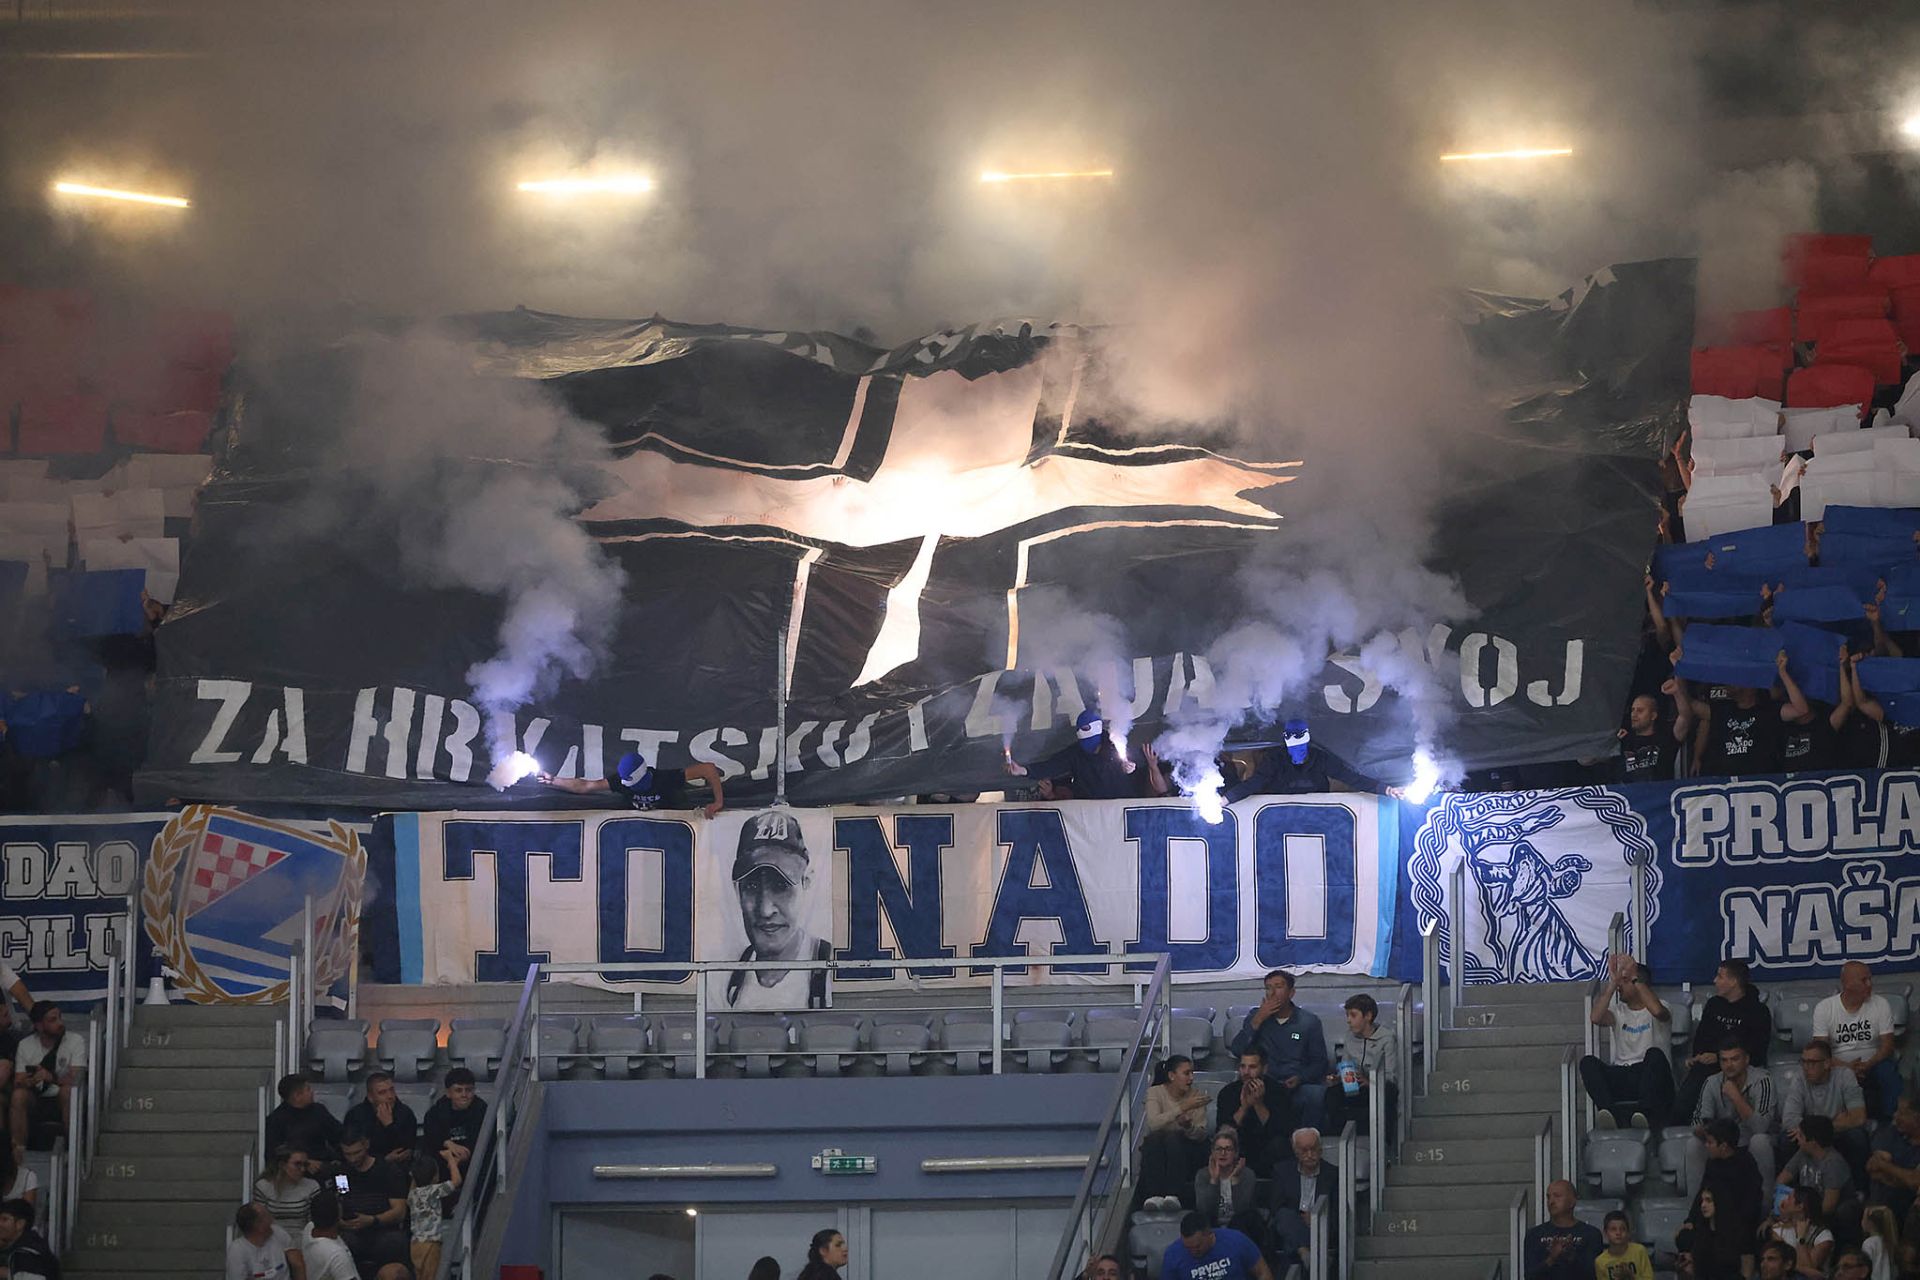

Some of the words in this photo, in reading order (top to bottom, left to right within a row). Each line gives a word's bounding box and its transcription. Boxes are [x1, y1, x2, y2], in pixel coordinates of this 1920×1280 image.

[190, 680, 307, 764] ZA
[1465, 790, 1538, 820] TORNADO
[1474, 824, 1523, 844] ZADAR
[1836, 1020, 1871, 1035] JACK&
[1836, 1031, 1872, 1044] JONES
[1190, 1257, 1231, 1279] PRVACI
